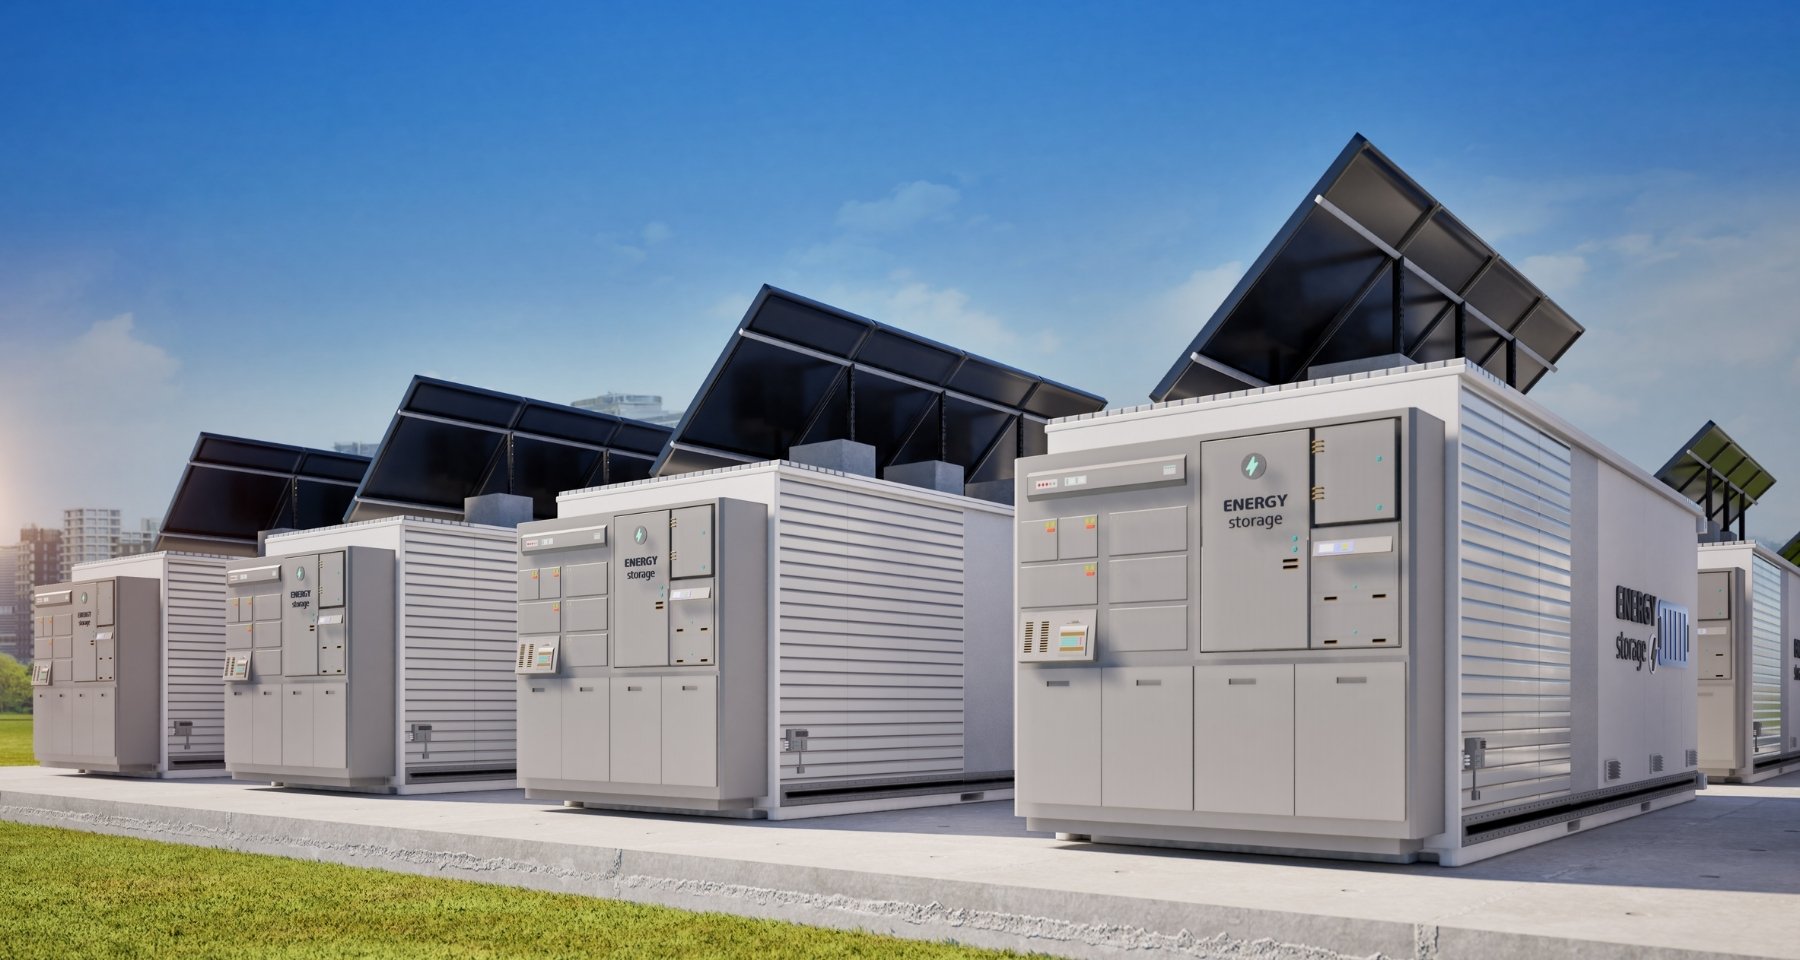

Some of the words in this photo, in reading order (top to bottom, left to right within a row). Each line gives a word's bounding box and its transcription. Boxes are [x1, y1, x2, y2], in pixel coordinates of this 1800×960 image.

[1223, 494, 1288, 512] ENERGY
[1228, 513, 1283, 530] storage
[624, 555, 658, 568] ENERGY
[627, 568, 656, 581] storage
[290, 589, 311, 599] ENERGY
[1615, 585, 1657, 626] ENERGY
[1615, 631, 1647, 671] storage
